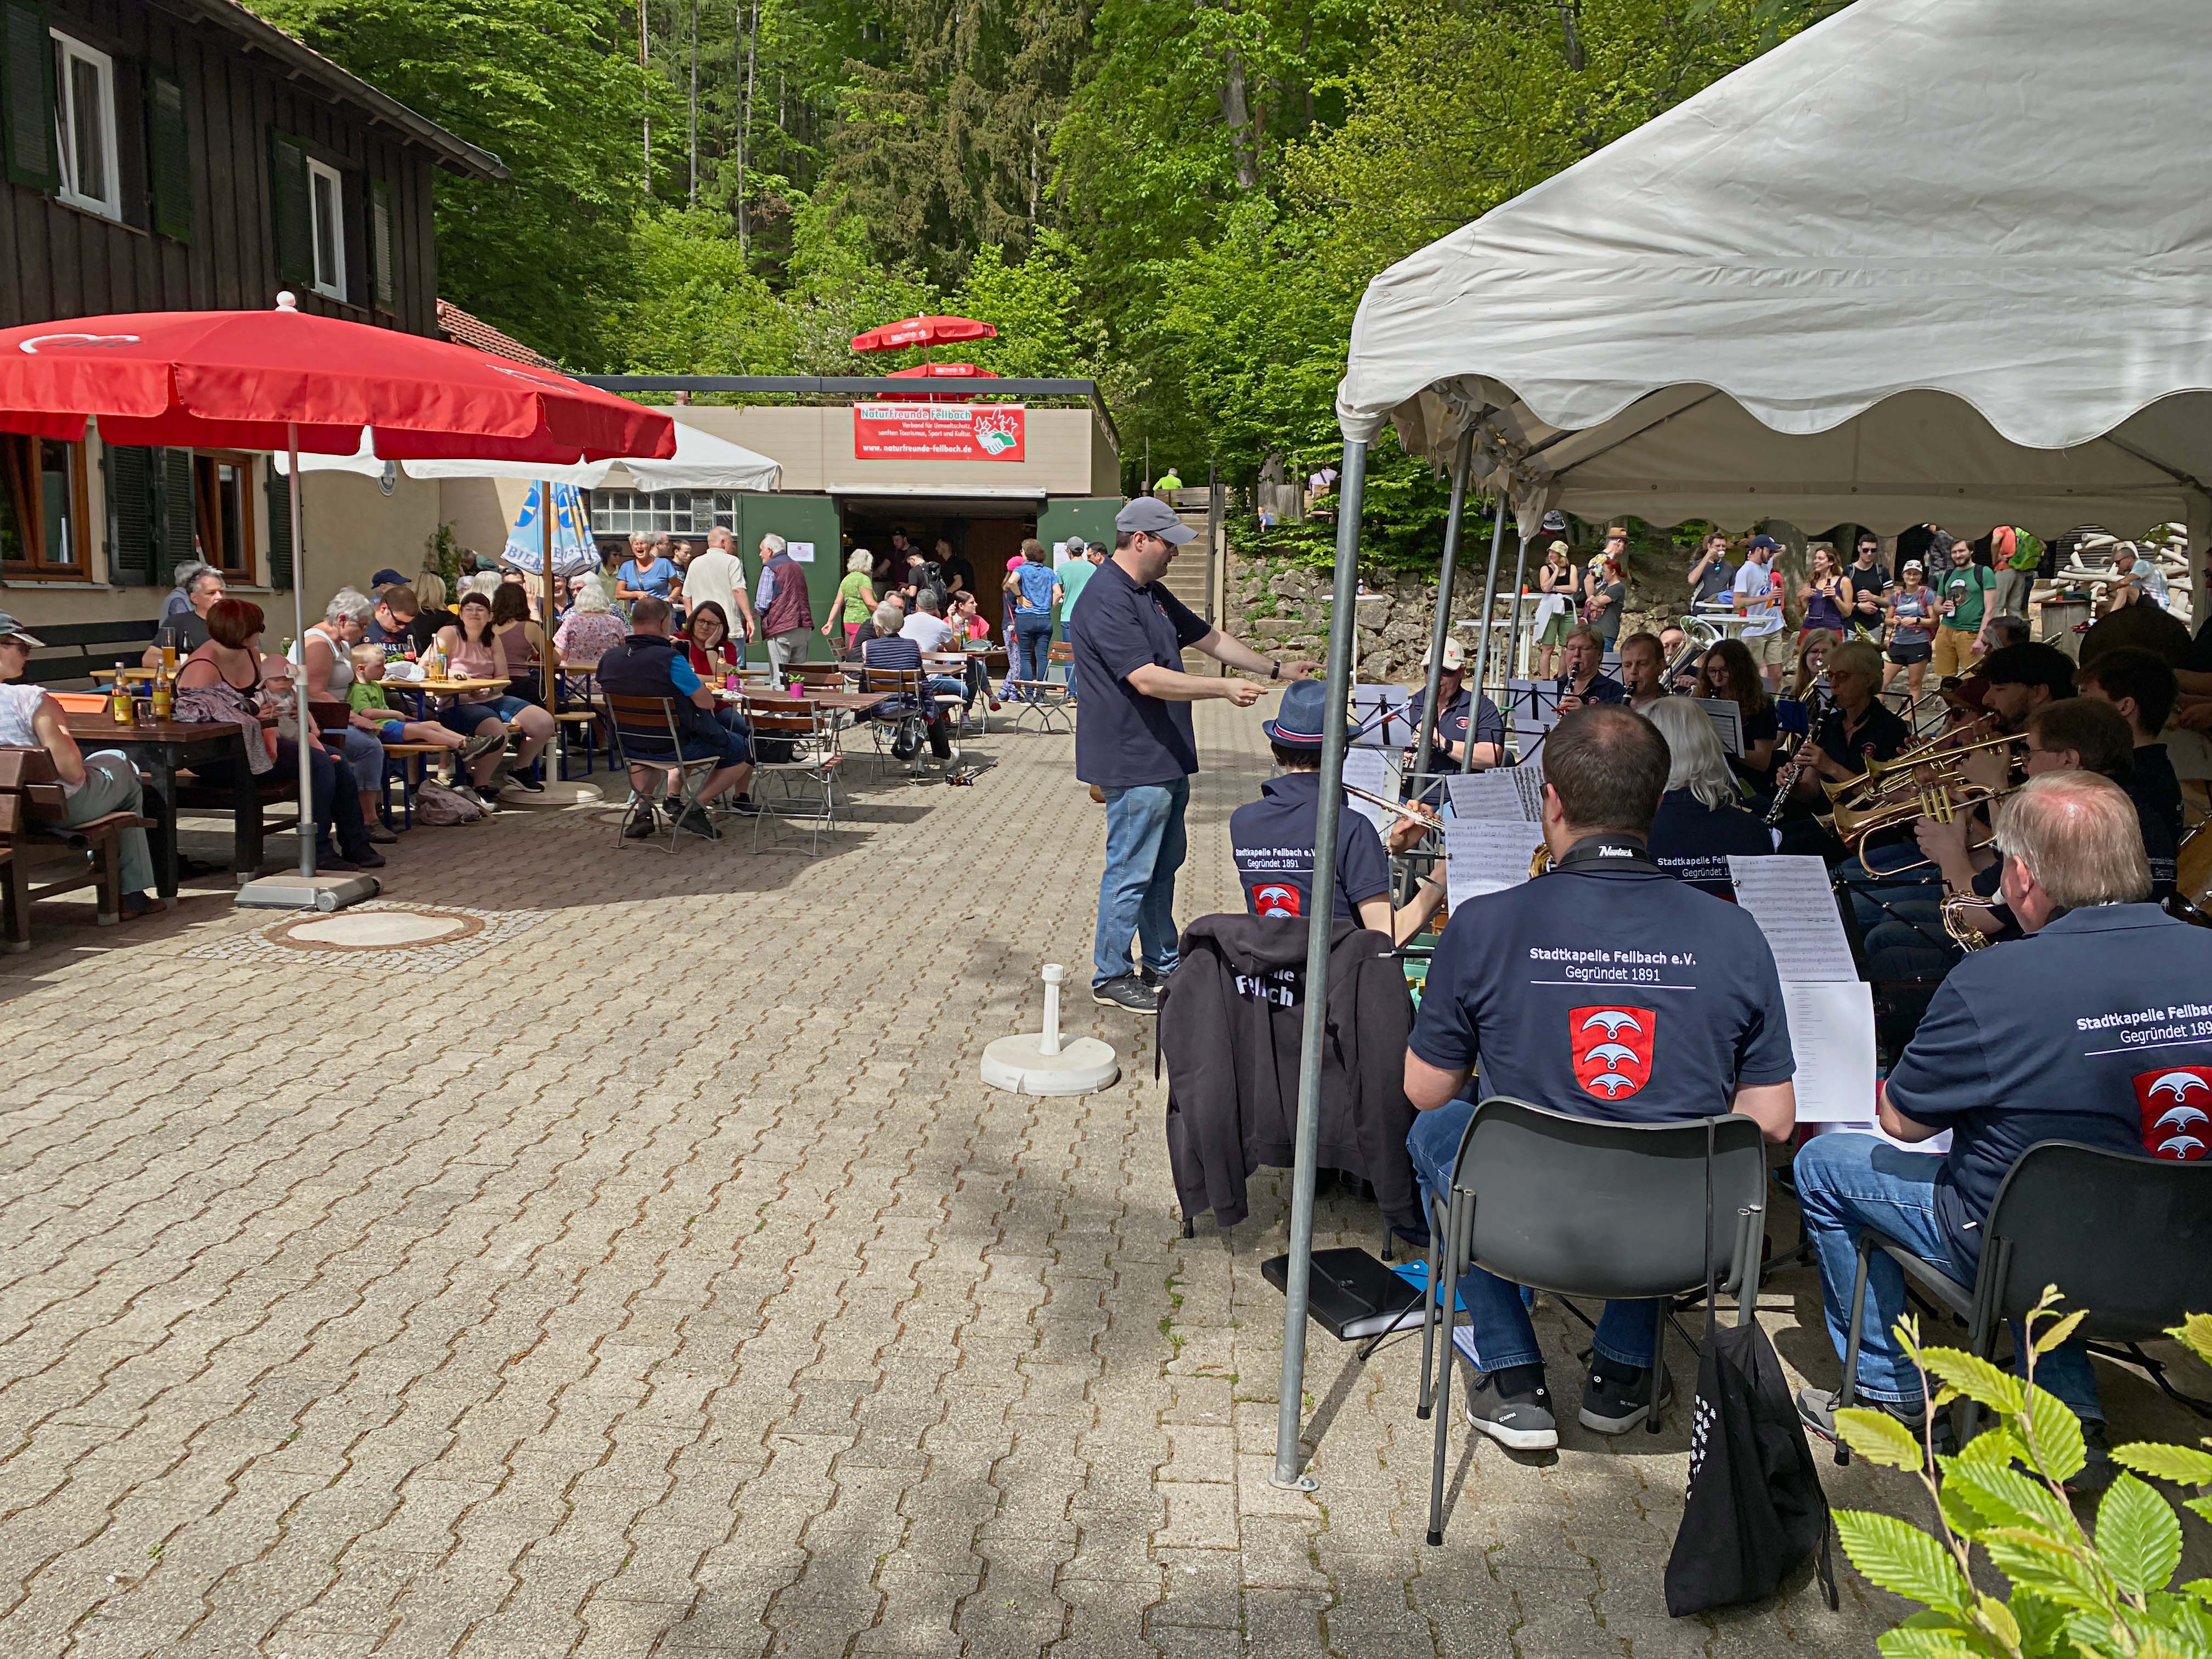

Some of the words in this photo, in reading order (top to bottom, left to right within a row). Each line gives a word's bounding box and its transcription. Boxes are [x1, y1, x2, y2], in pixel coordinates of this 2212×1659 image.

[861, 408, 929, 419] NaturFreunde
[931, 409, 972, 420] Fellbach
[883, 444, 972, 453] naturfreunde-fellbach.de
[1272, 848, 1302, 857] Fellbach
[1304, 848, 1316, 857] e.V
[1247, 859, 1280, 869] Gegründet
[1282, 859, 1299, 868] 1891
[1657, 856, 1711, 867] Stadtkapelle
[1712, 856, 1728, 864] Fell
[1682, 867, 1723, 878] Gegründet
[1530, 947, 1611, 964] Stadtkapelle
[1613, 950, 1667, 964] Fellbach
[1671, 952, 1696, 966] e.V.
[1565, 965, 1628, 981] Gegründet
[1632, 967, 1661, 981] 1891
[2076, 1008, 2165, 1030] Stadtkapelle
[2168, 1003, 2212, 1019] Fellbac
[2120, 1024, 2188, 1045] Gegründet
[2190, 1020, 2212, 1036] 189
[1498, 1412, 1517, 1423] SCARPA
